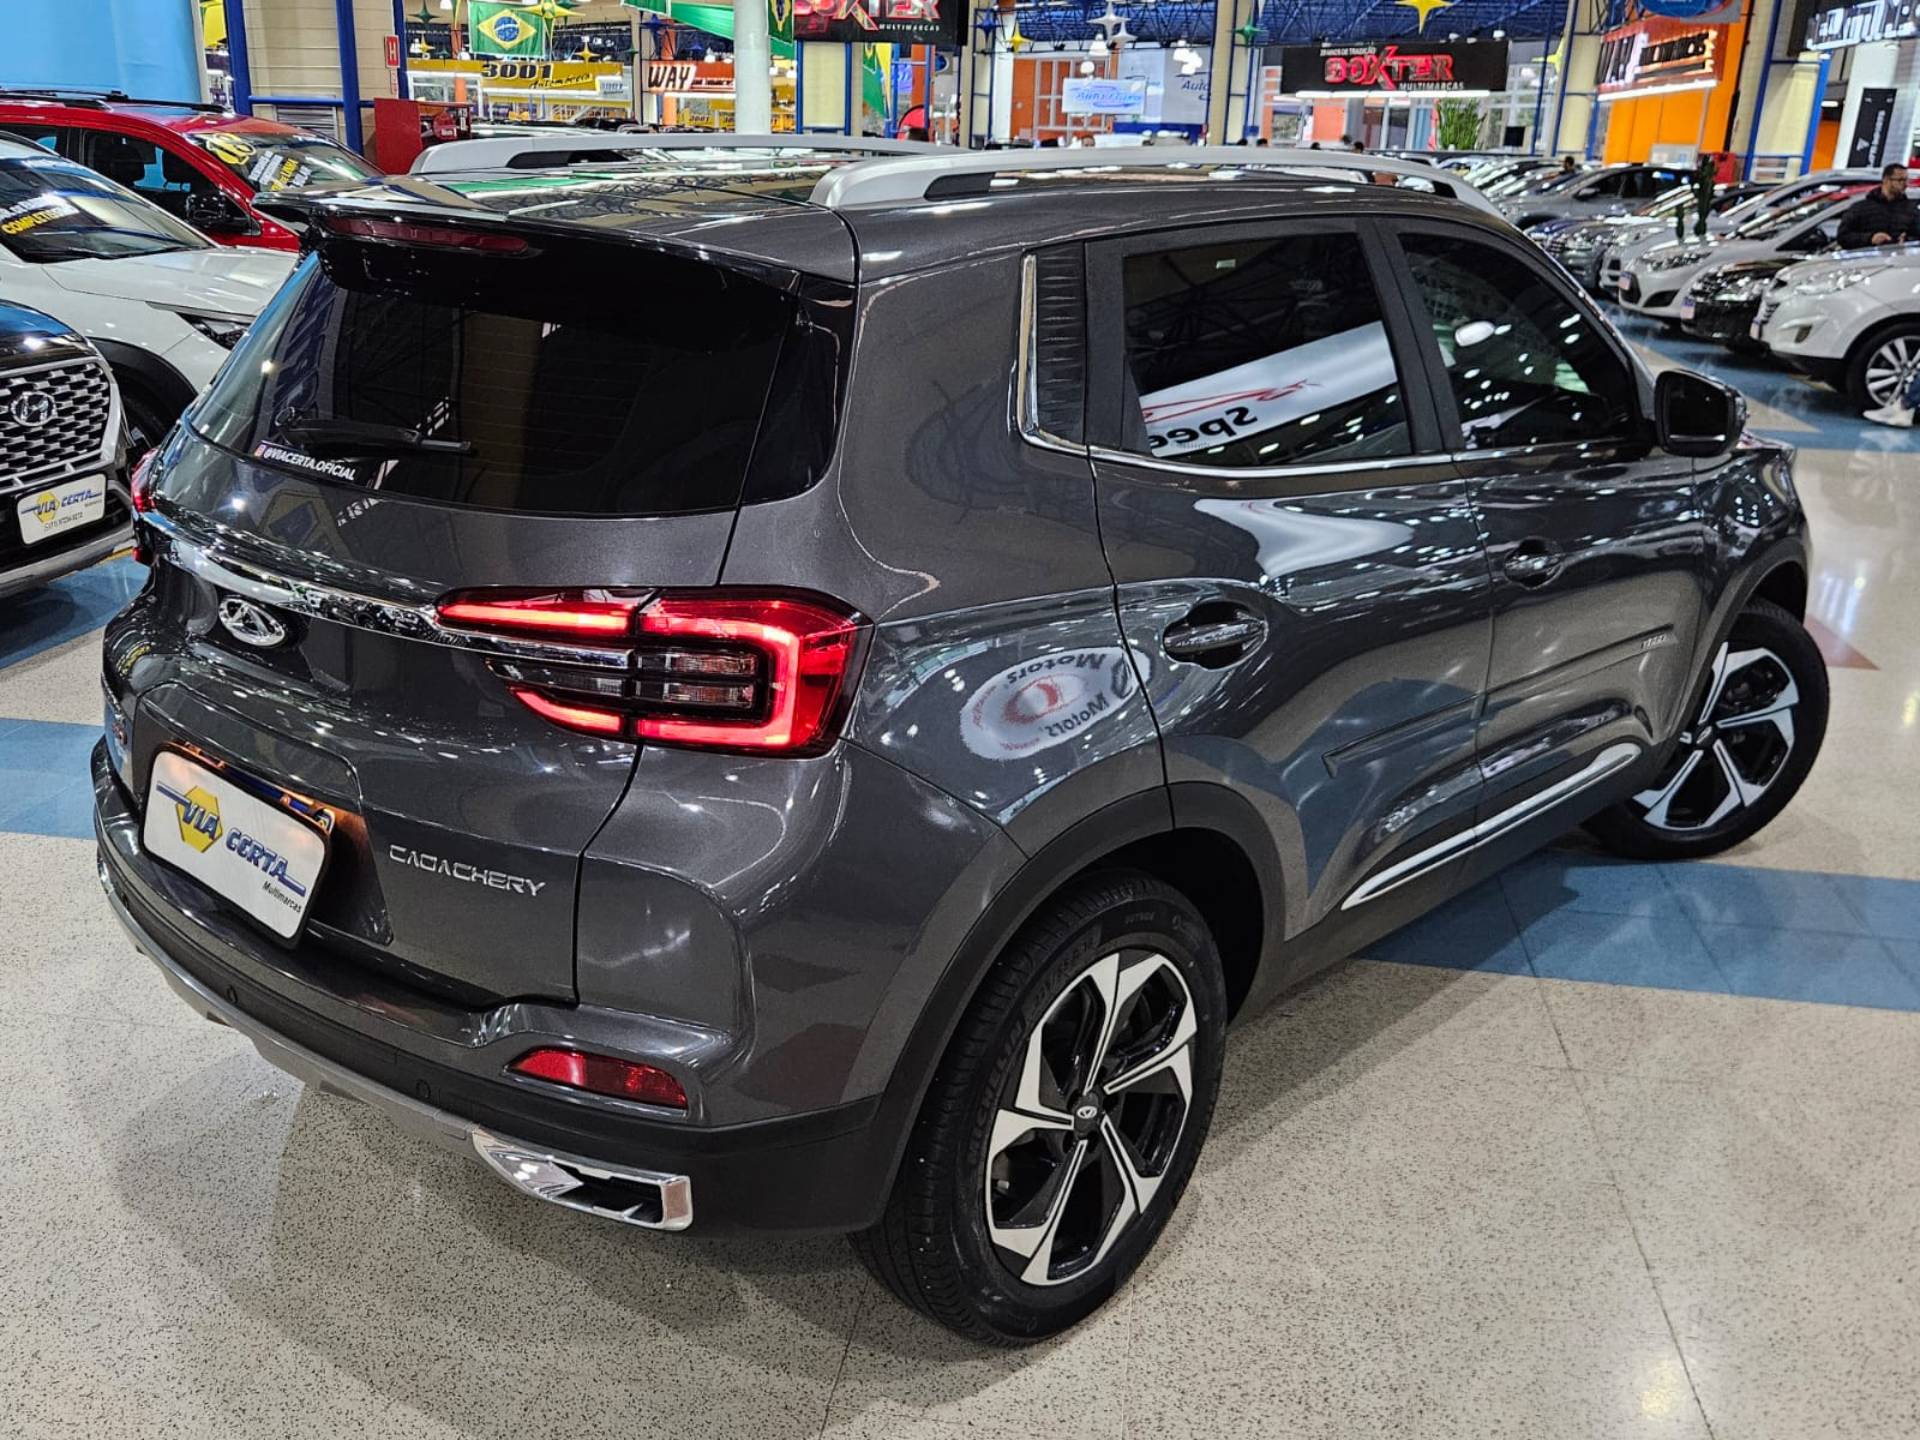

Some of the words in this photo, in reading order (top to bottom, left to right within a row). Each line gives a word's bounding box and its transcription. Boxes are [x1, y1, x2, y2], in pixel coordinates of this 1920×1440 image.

[879, 23, 940, 32] MULTIMARCAS
[481, 63, 553, 80] 3001
[648, 66, 690, 88] WAY
[1325, 46, 1454, 91] BOXTER
[1399, 82, 1464, 91] MULTIMARCAS
[263, 446, 355, 481] @VIACERTA.OFICIAL
[61, 489, 93, 507] CERTA
[181, 800, 219, 840] VIA
[225, 827, 289, 878] CERTA
[262, 880, 303, 913] Multimarcas
